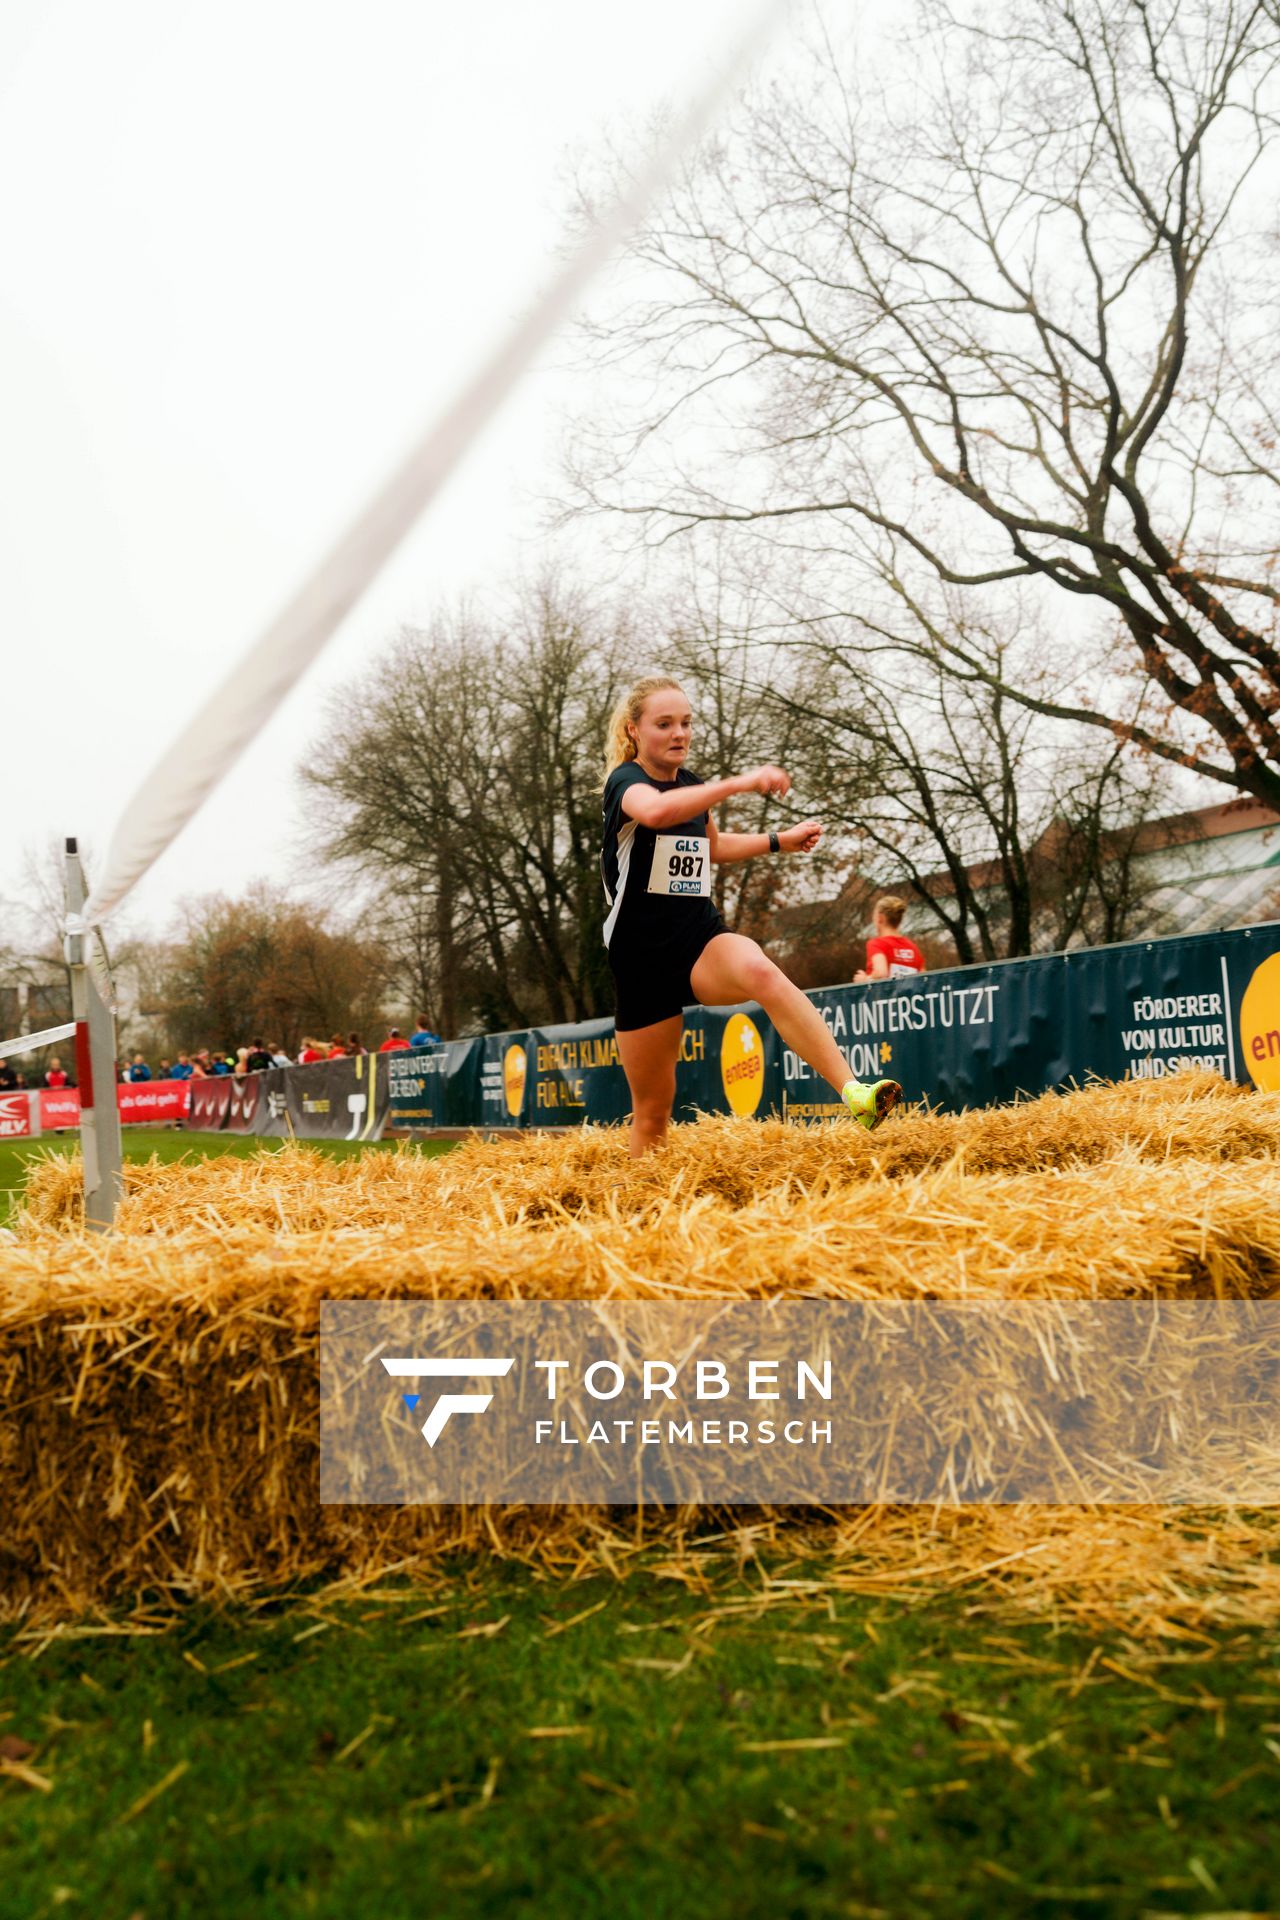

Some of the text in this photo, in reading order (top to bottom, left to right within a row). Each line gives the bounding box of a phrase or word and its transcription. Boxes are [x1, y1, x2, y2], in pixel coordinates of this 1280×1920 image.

[675, 840, 699, 852] GLS
[668, 855, 704, 877] 987
[851, 985, 1000, 1036] UNTERSTÜTZT
[1133, 993, 1223, 1021] FÖRDERER
[1121, 1024, 1225, 1051] VON KULTUR
[580, 1036, 623, 1068] KLIMA
[783, 1050, 811, 1080] DIE
[726, 1055, 760, 1085] entega
[1131, 1057, 1165, 1079] UND
